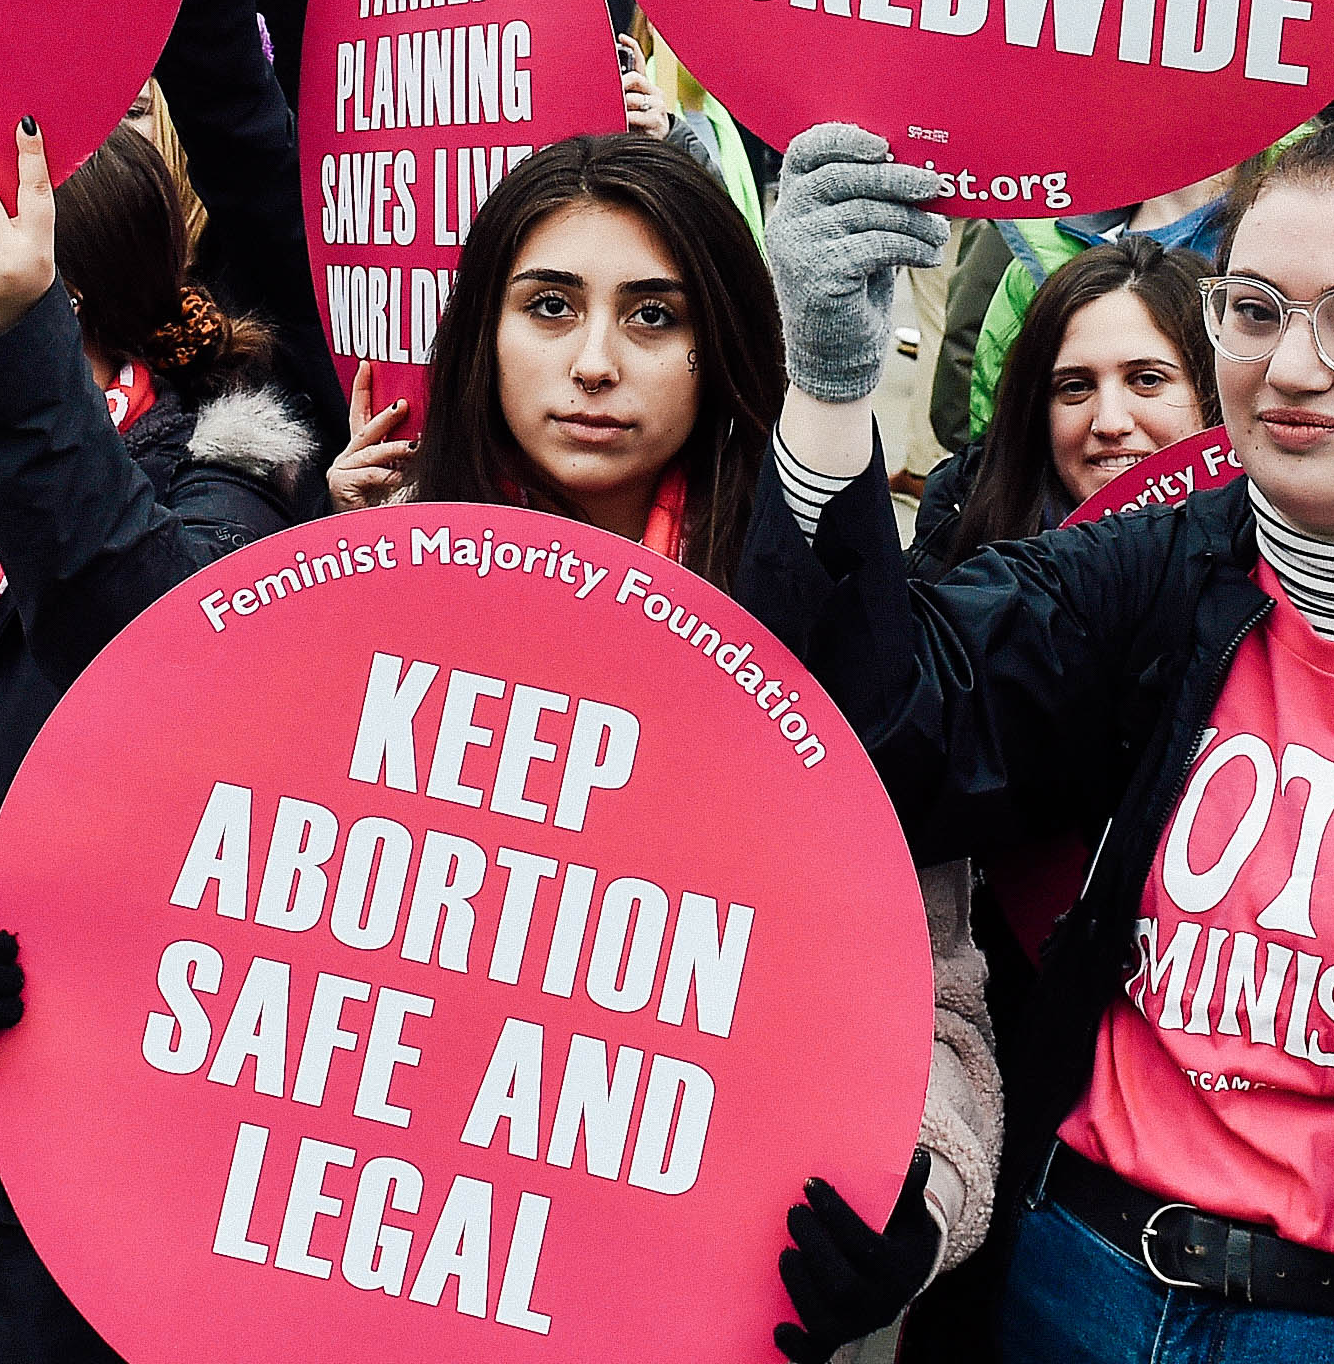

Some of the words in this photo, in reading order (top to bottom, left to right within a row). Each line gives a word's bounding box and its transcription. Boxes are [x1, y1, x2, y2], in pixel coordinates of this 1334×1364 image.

[337, 21, 531, 132] PLANNING
[322, 150, 415, 245] SAVES
[200, 536, 396, 631] Feminist
[412, 528, 608, 598] Majority
[616, 568, 825, 767] Foundation
[349, 652, 639, 831] KEEP
[170, 782, 754, 1038] ABORTION
[143, 941, 434, 1128] SAFE
[461, 1018, 714, 1194] AND
[213, 1123, 551, 1334] LEGAL
